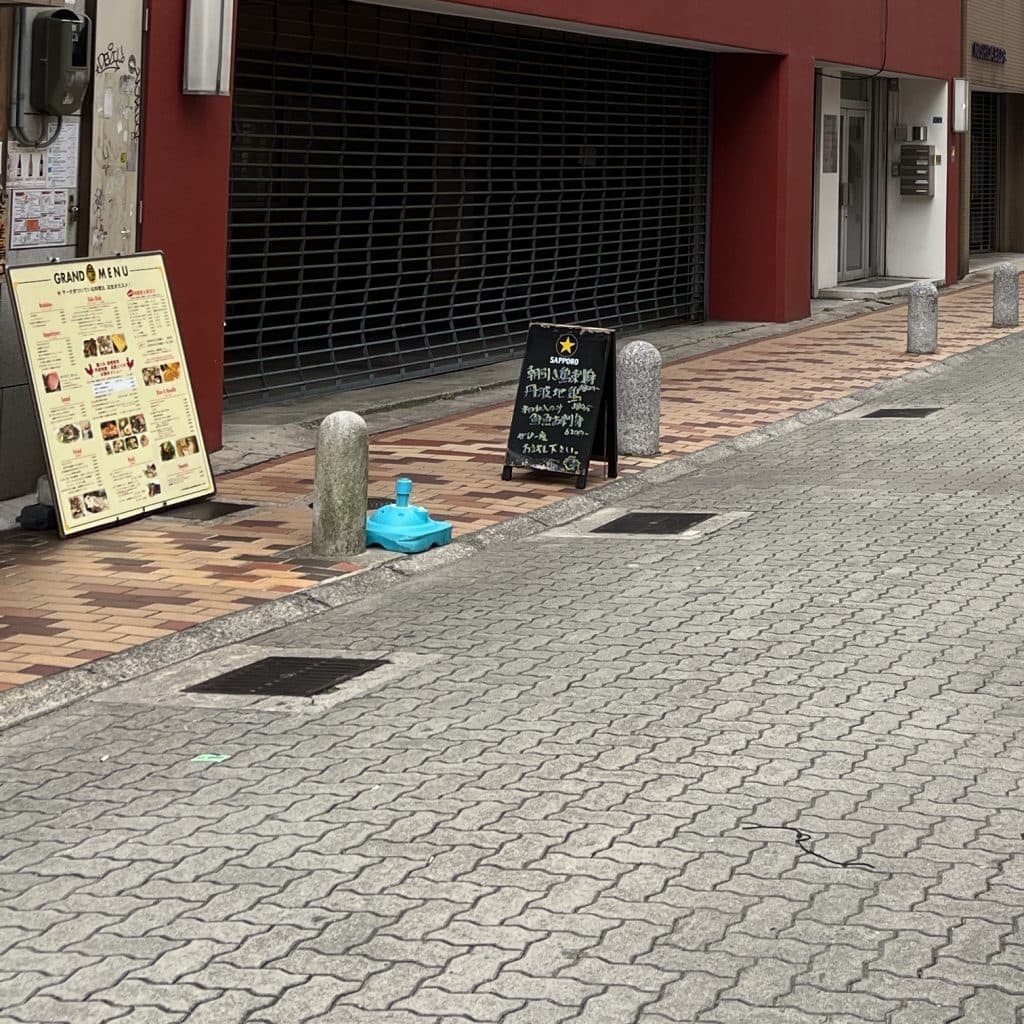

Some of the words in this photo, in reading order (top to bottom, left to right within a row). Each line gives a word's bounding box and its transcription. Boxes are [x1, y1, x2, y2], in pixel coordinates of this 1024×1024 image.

[53, 270, 85, 285] GRAND
[98, 266, 129, 279] MENU
[549, 356, 580, 366] SAPPORO
